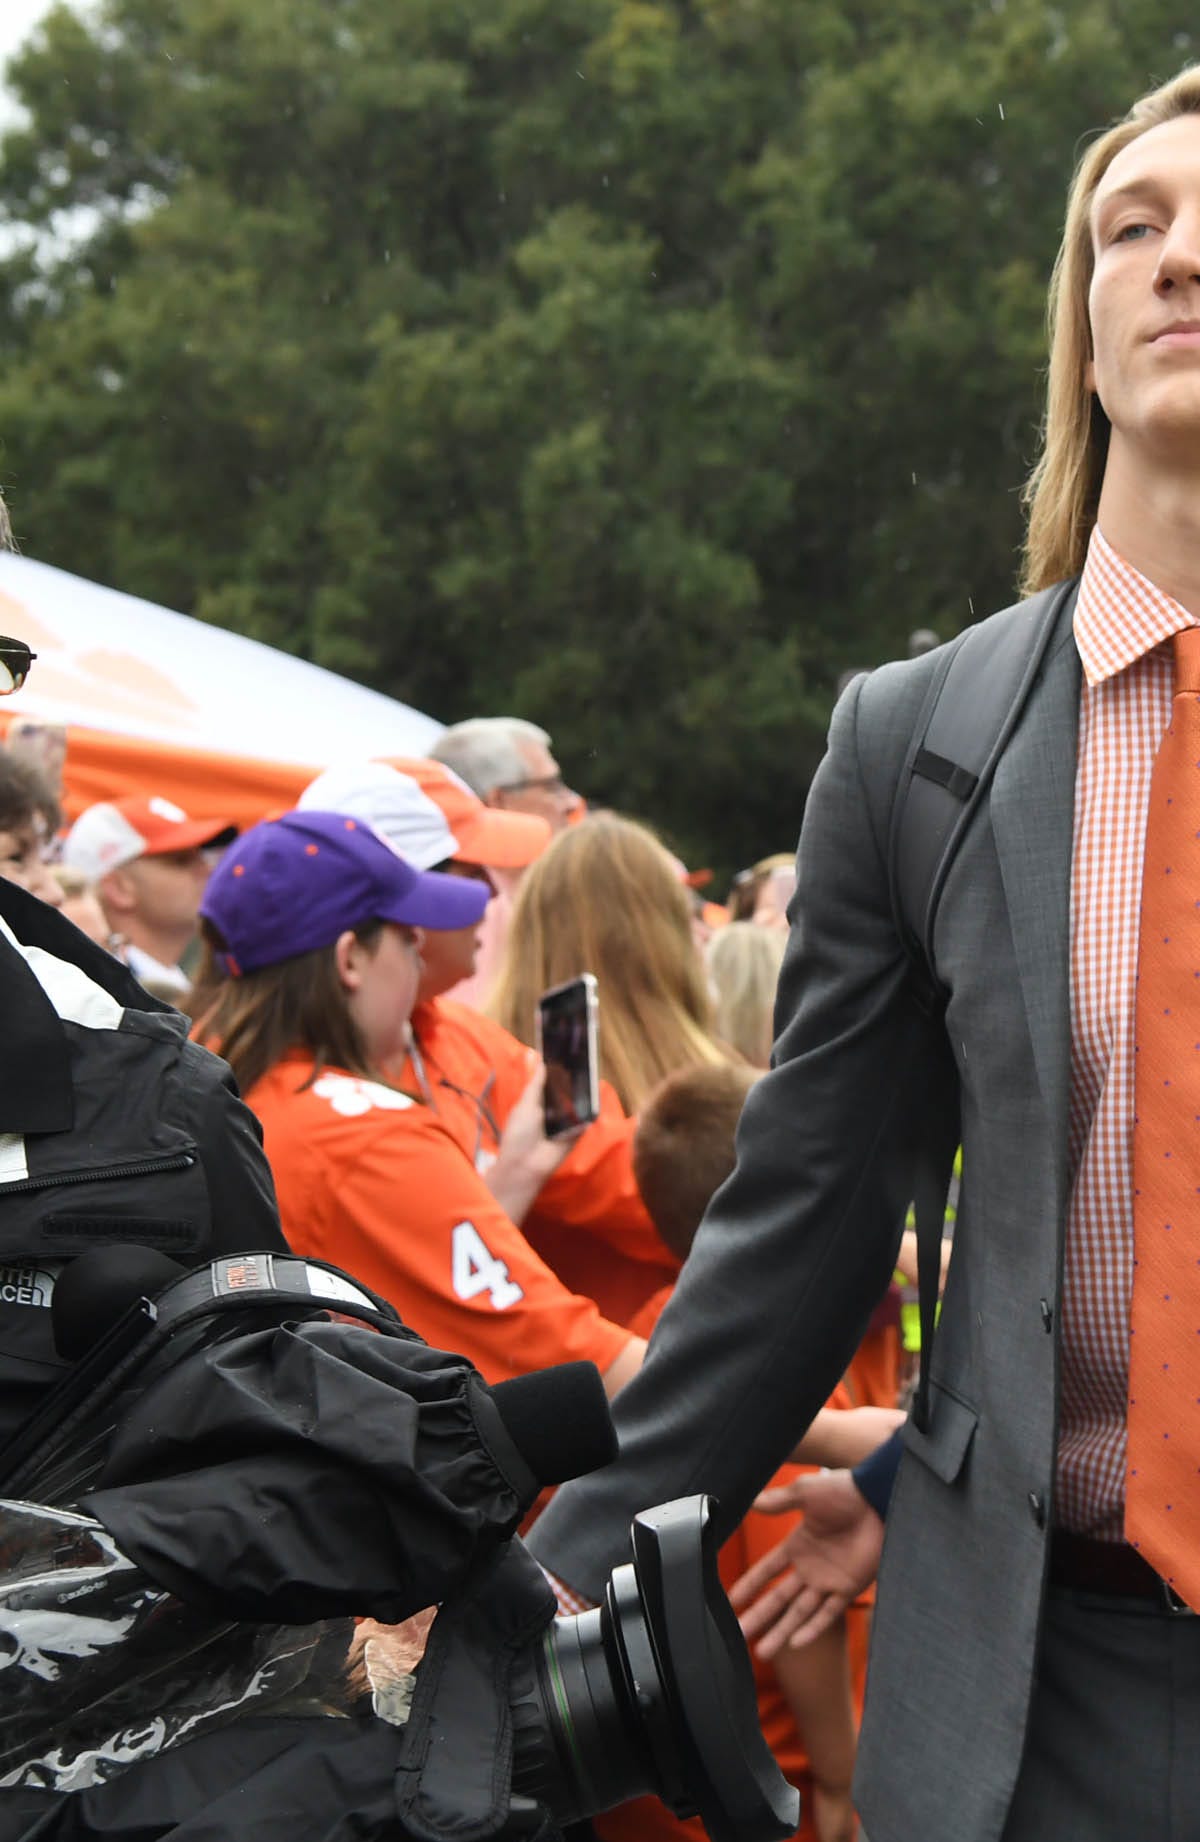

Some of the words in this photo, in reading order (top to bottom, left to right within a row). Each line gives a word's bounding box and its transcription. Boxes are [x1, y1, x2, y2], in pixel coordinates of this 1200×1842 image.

[452, 1219, 525, 1310] 4
[0, 1268, 33, 1288] TH
[0, 1284, 33, 1305] CE
